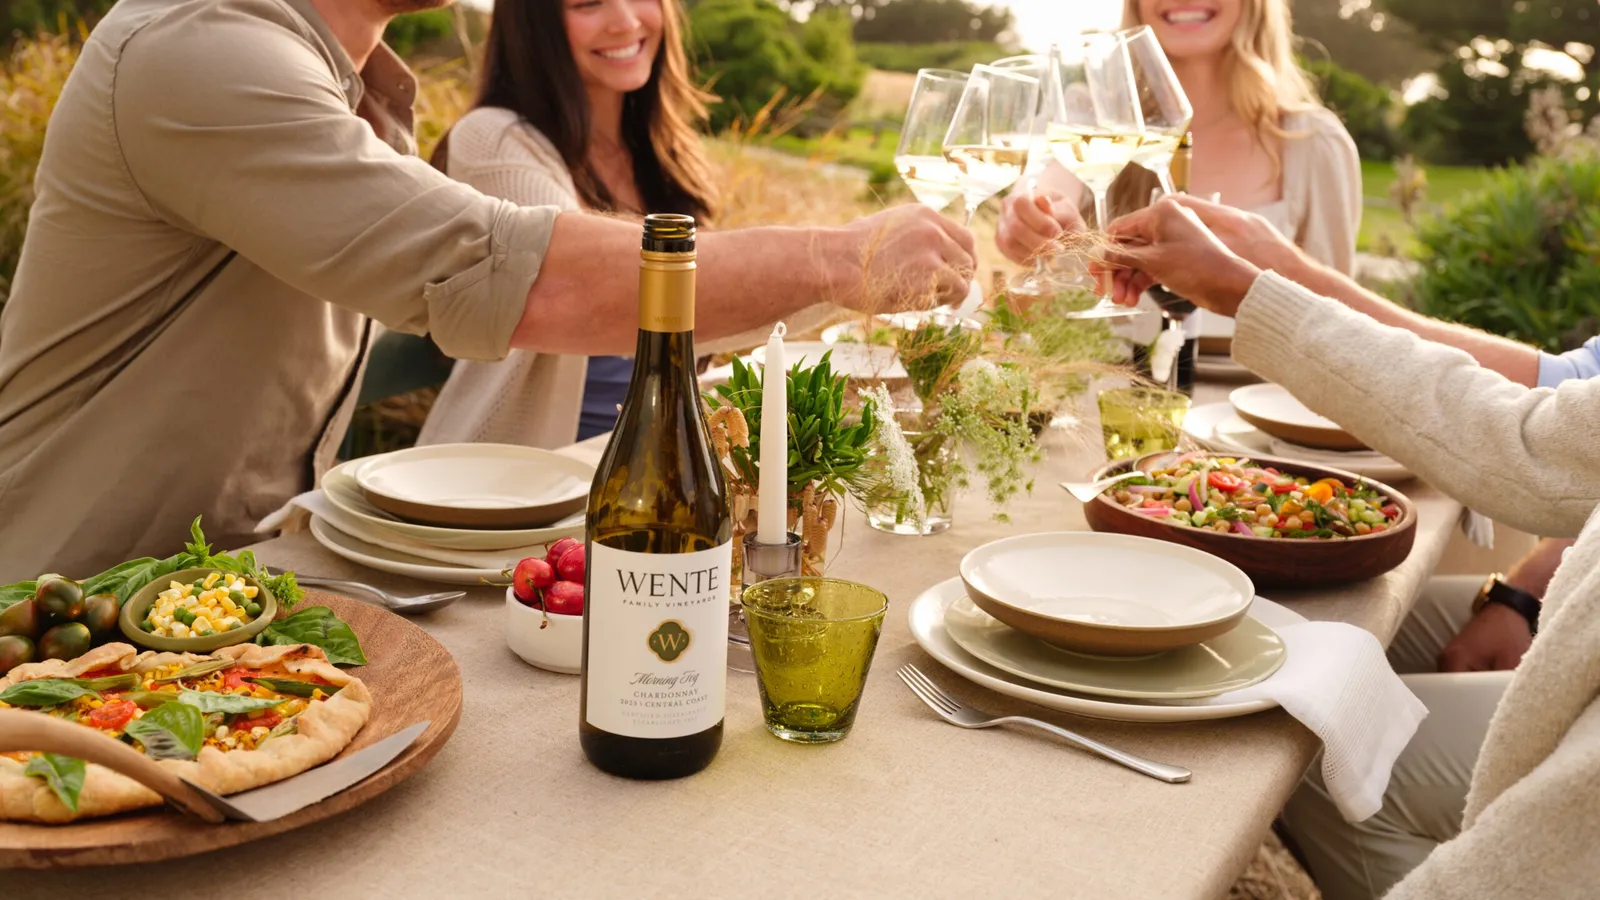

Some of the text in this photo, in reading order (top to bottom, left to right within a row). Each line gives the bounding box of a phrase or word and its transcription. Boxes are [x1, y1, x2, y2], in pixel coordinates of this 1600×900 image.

[616, 566, 719, 597] WENTE
[622, 595, 716, 608] FAMILY VINEYARDS
[657, 632, 682, 651] W
[629, 672, 679, 689] Morning
[620, 698, 637, 706] 2023
[645, 700, 683, 708] CENTRAL
[685, 694, 708, 705] COAST
[633, 688, 698, 699] CHARDONNAY
